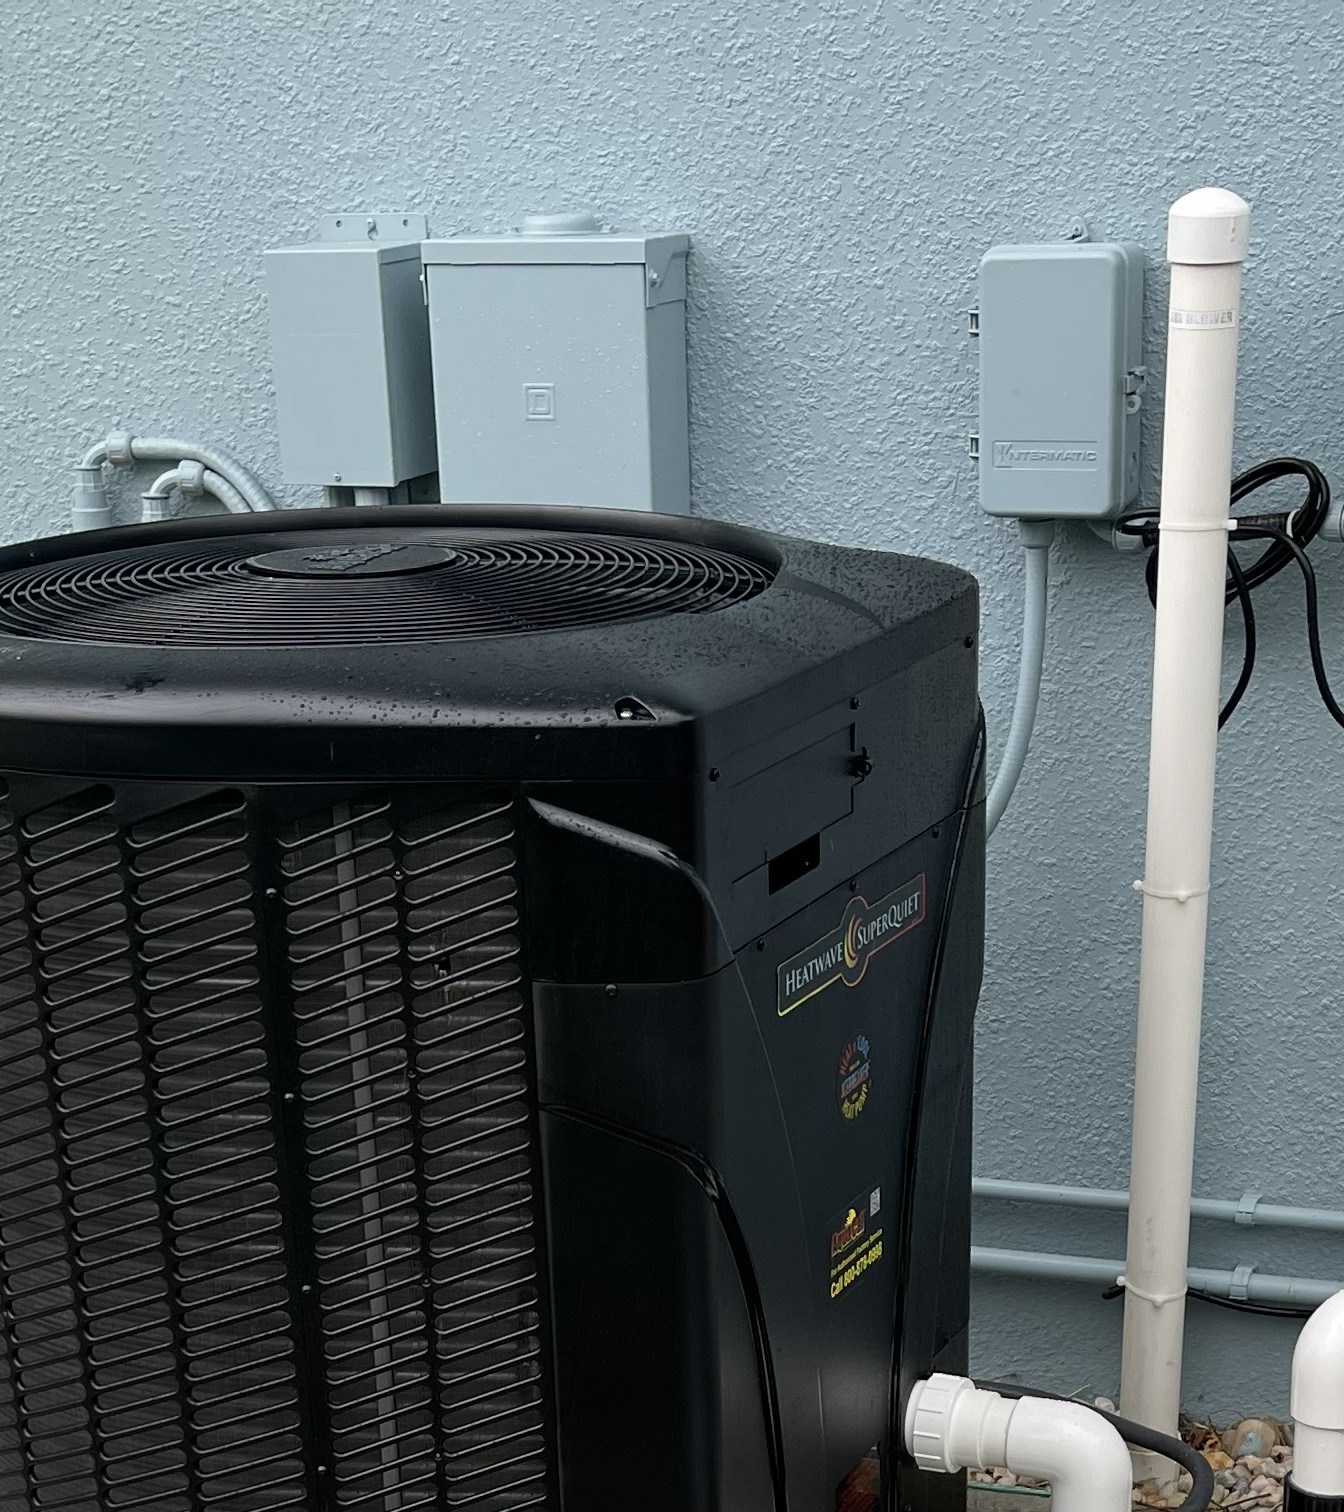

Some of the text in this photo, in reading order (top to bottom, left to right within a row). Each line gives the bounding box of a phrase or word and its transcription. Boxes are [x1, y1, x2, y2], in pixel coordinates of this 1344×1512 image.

[1186, 311, 1233, 325] BLOWER
[994, 442, 1097, 468] INTERMATIC
[785, 891, 921, 996] HEATWAVE SUPERQUIET
[831, 1275, 843, 1298] Call
